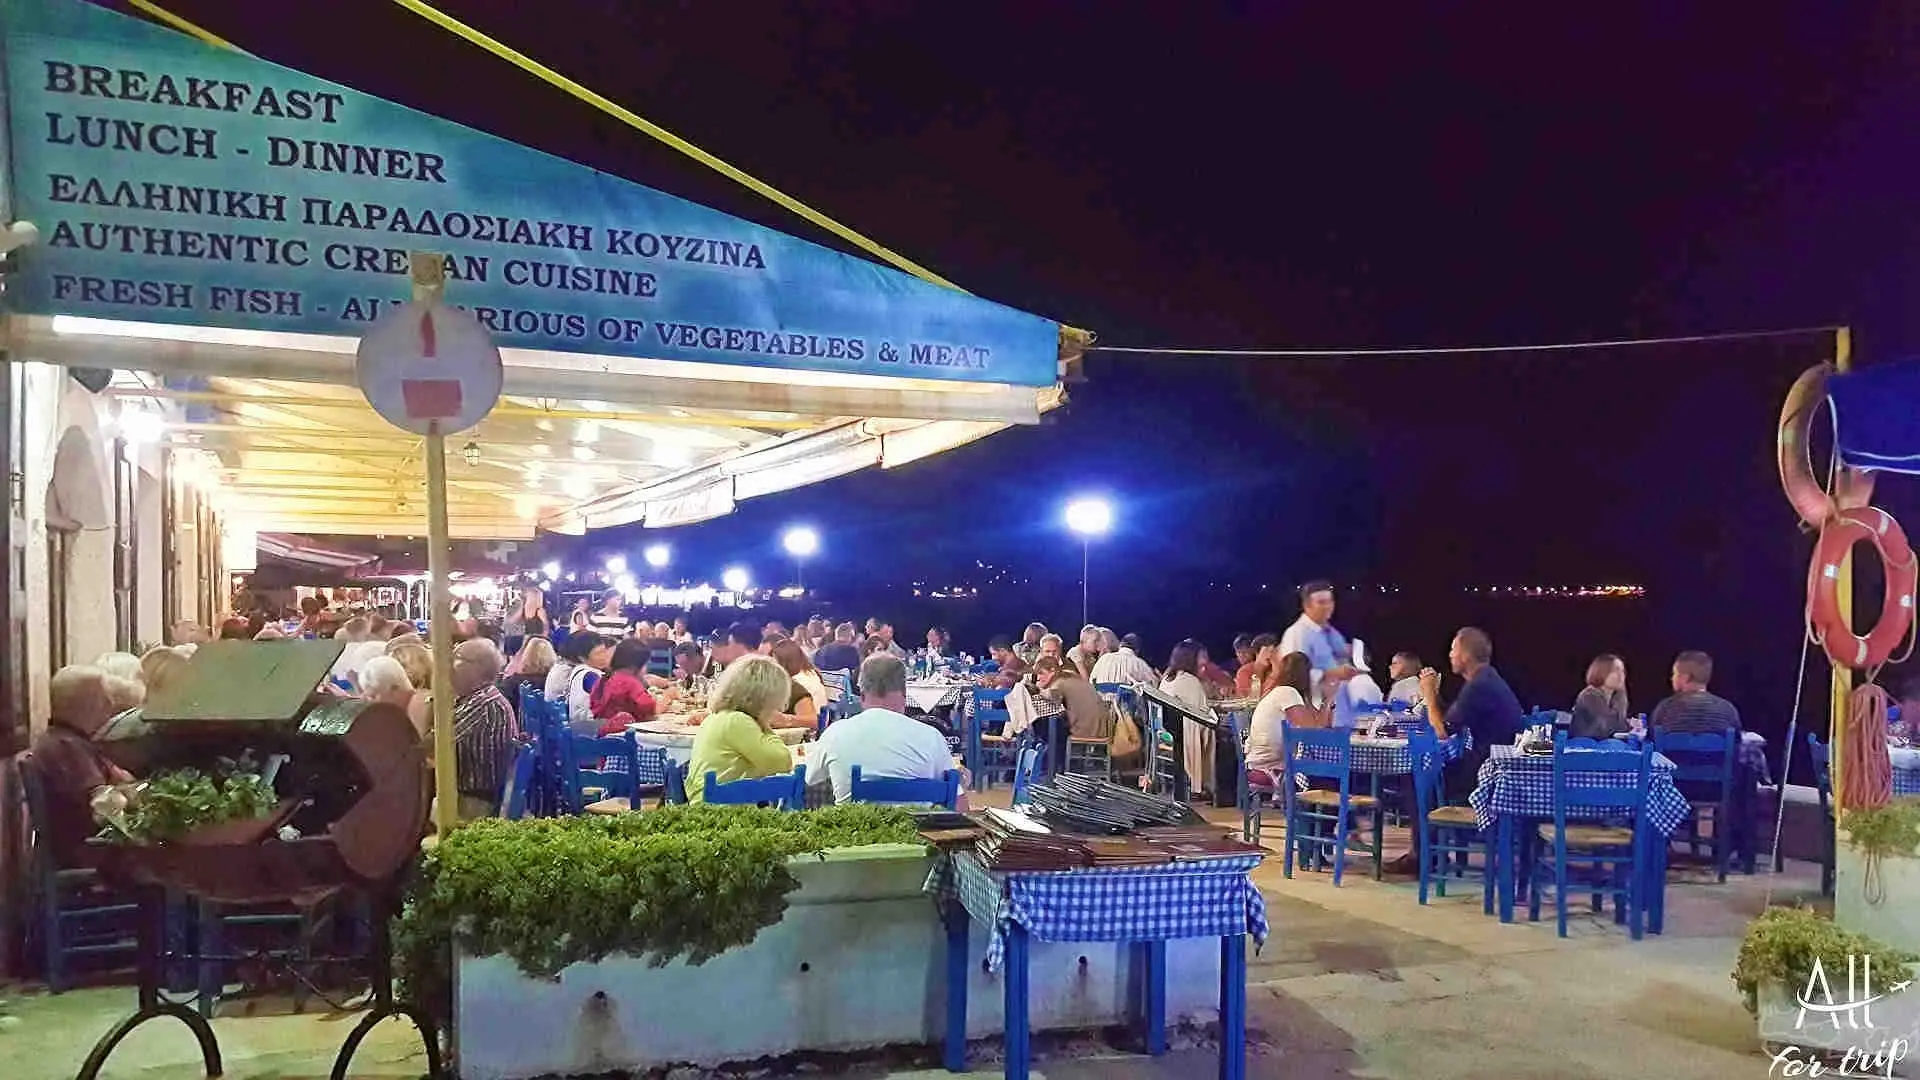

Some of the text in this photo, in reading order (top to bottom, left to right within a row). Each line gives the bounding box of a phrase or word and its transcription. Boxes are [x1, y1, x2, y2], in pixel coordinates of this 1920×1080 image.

[44, 61, 344, 123] BREAKFAST
[46, 112, 217, 159] LUNCH
[267, 136, 446, 183] DINNER
[48, 174, 766, 269] ΕΛΛΗΝΙΚΗ ΠΑΡΑΔΟΣΙΑΚΗ ΚΟΥΖΙΝΑ
[49, 220, 657, 298] AUTHENTIC CREAN CUISINE
[53, 275, 193, 308] FRESH
[210, 286, 302, 316] FISH
[599, 318, 644, 343] OF
[656, 322, 864, 360] VEGETABLES
[878, 342, 898, 363] &
[909, 343, 990, 369] MEAT
